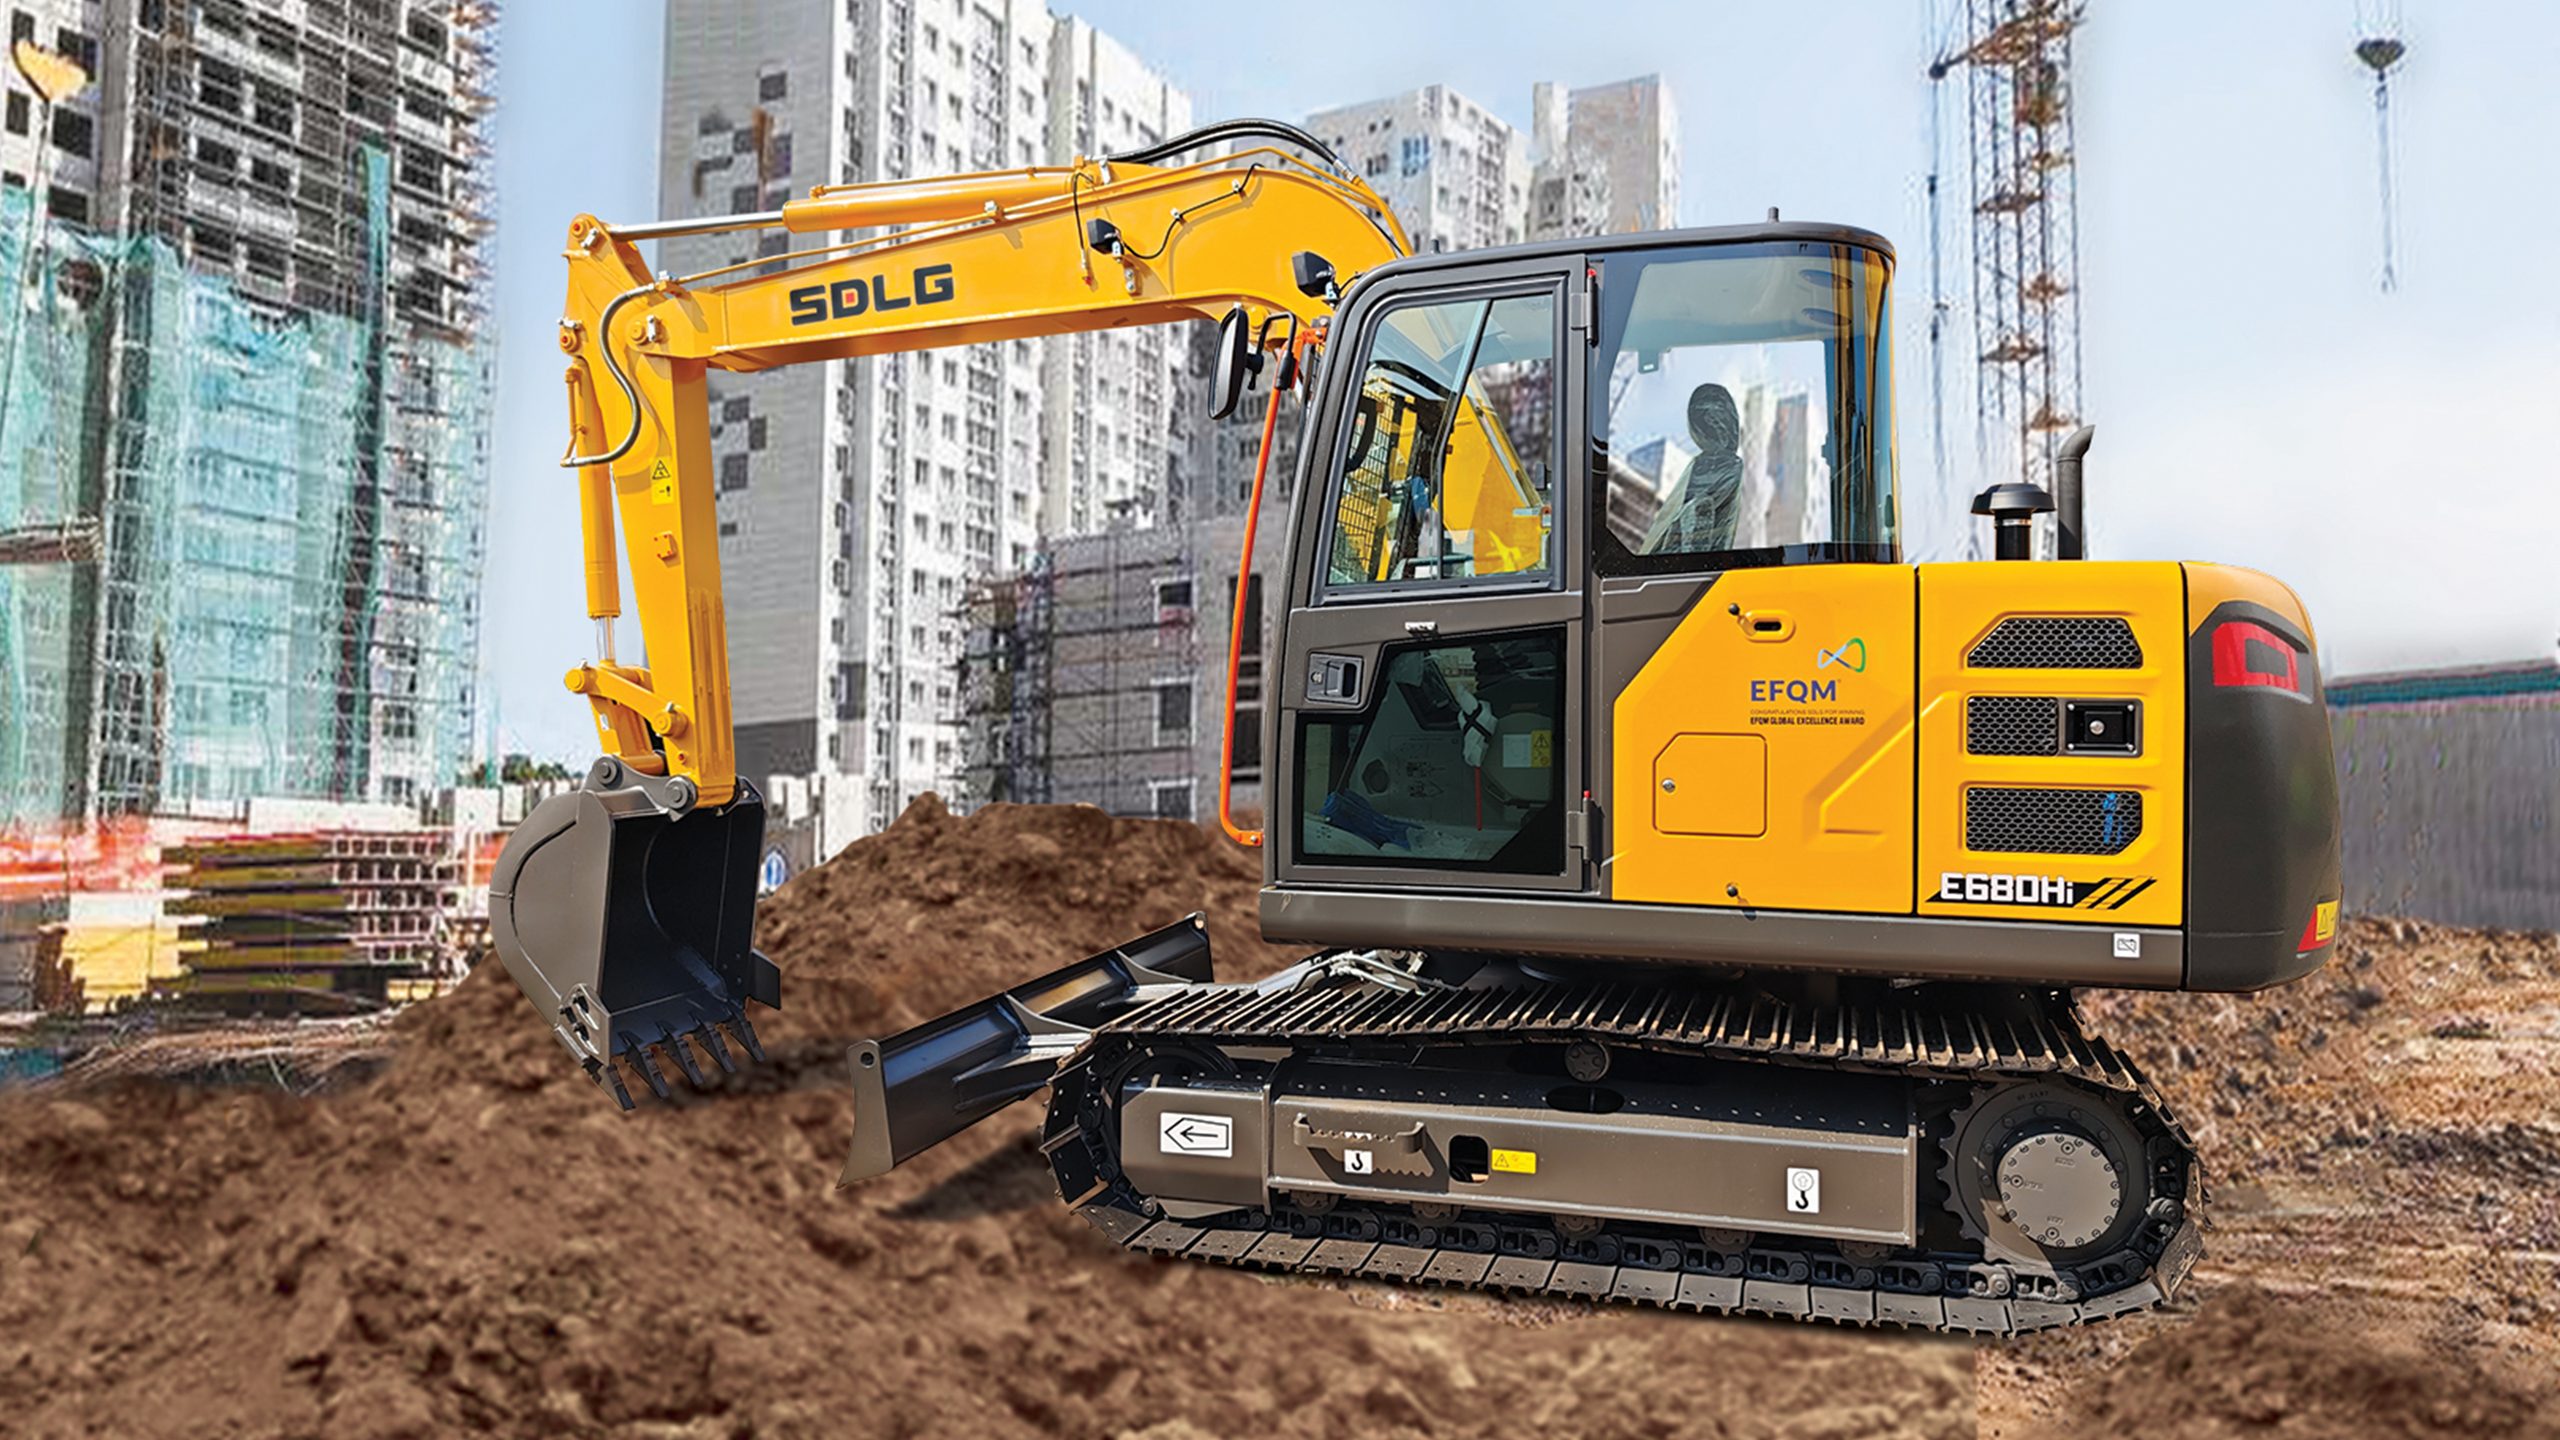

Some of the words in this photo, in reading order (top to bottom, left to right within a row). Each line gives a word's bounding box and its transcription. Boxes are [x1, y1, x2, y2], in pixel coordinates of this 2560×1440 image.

[789, 263, 954, 326] SDLG
[1751, 680, 1836, 703] EFQM
[1750, 717, 1768, 725] EFQM
[1770, 717, 1795, 725] GLOBAL
[1797, 717, 1837, 725] EXCELLENCE
[1839, 717, 1865, 725] AWARD
[1939, 871, 2074, 905] E680Hi
